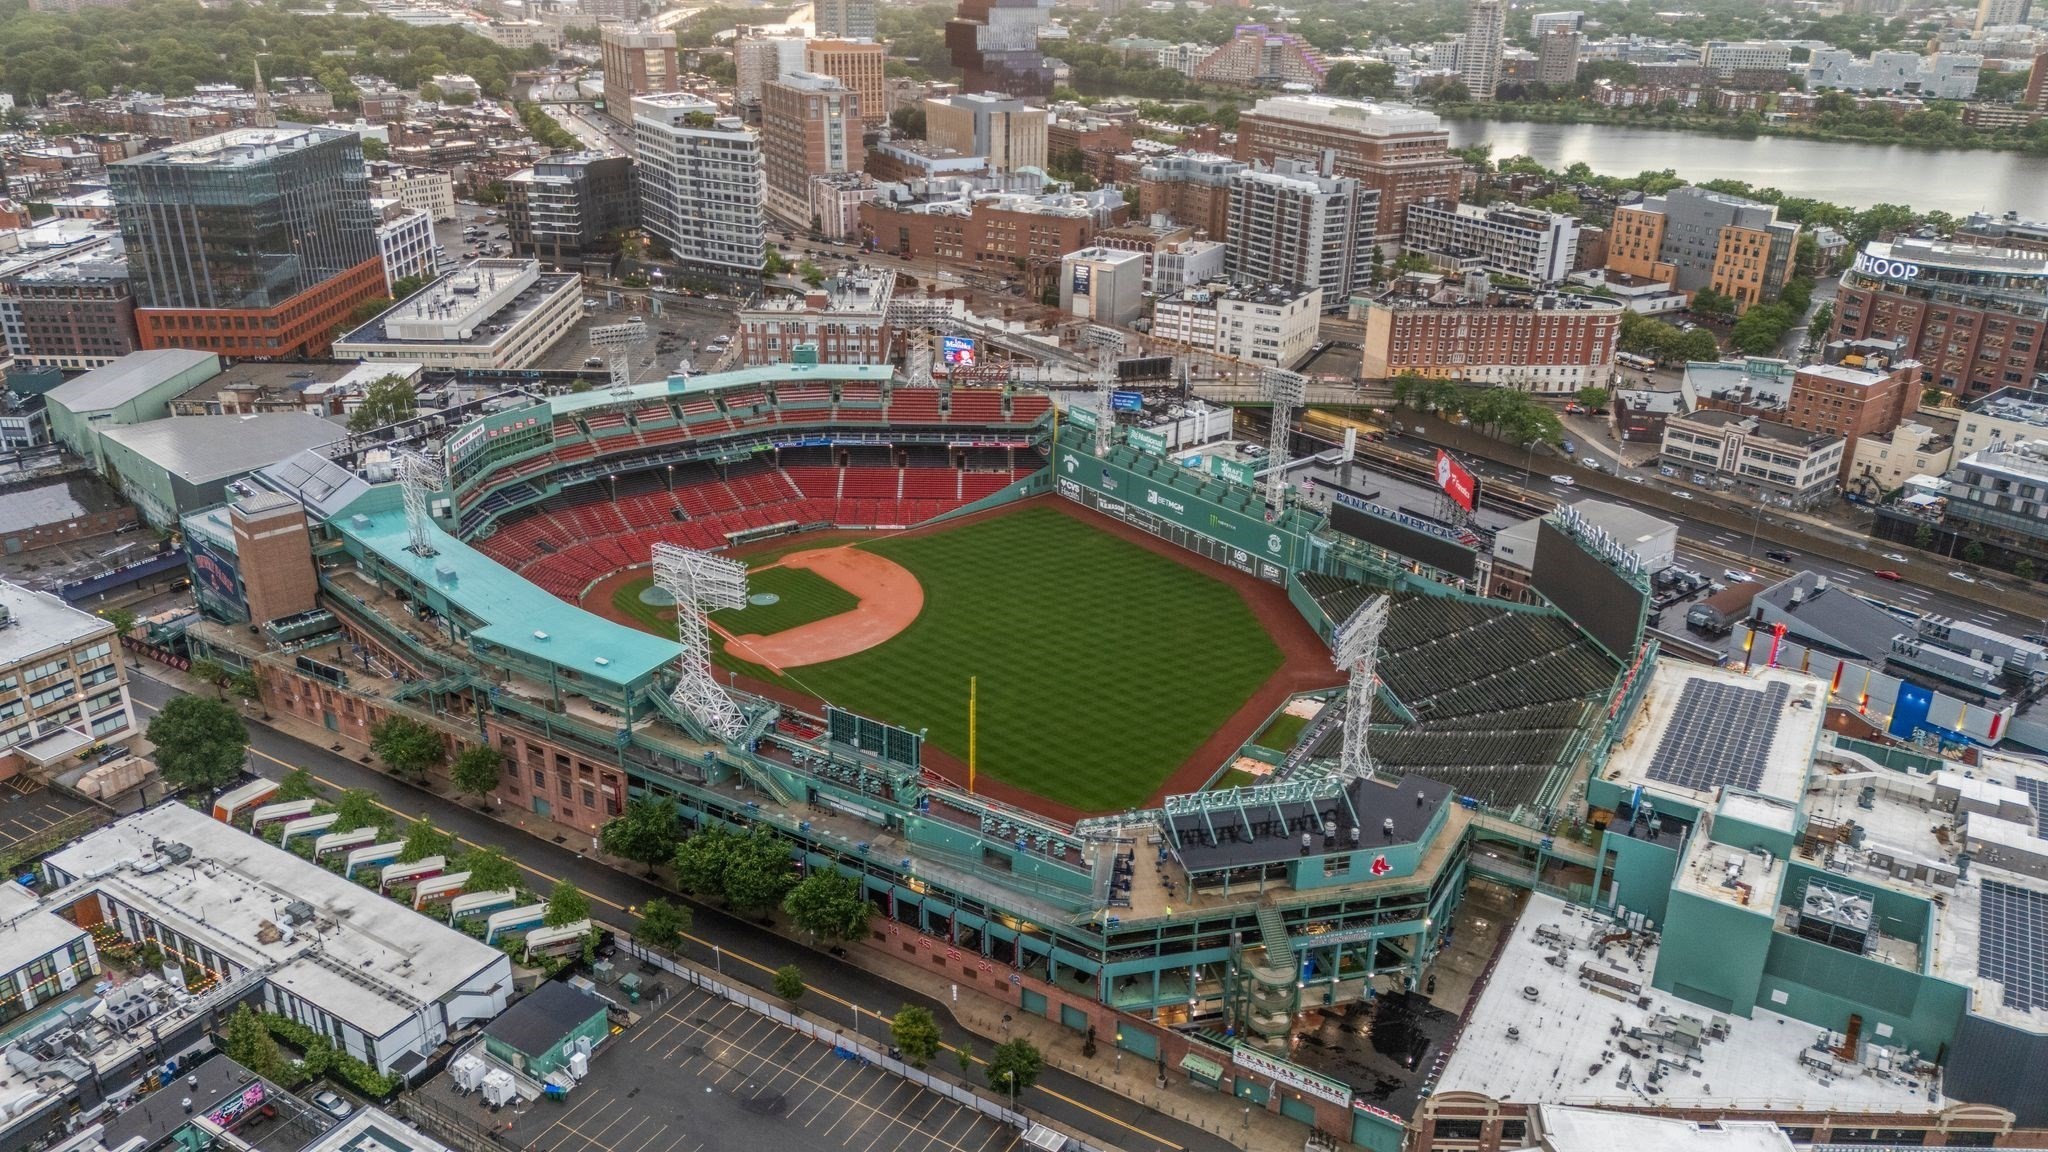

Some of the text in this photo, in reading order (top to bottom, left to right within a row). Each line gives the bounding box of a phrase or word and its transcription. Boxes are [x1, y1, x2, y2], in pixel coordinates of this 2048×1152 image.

[1852, 251, 1918, 280] WHOOP
[454, 436, 471, 449] FENWAY
[472, 427, 483, 438] PARK
[1139, 432, 1163, 447] National
[1221, 465, 1244, 476] DRAFT
[1061, 486, 1080, 501] Health
[1066, 481, 1080, 493] CVS
[1157, 496, 1184, 513] BETMGM
[1337, 491, 1449, 538] BANK OF AMERICA
[1565, 505, 1640, 574] MassMutual
[126, 561, 141, 569] TEAM
[142, 556, 158, 565] STORE
[888, 924, 900, 936] 14
[918, 937, 932, 950] 45
[946, 947, 961, 961] 26
[978, 961, 994, 973] 34
[1009, 973, 1021, 985] 42
[1236, 1051, 1298, 1078] FENWAY
[1303, 1077, 1346, 1100] PARK
[1353, 1099, 1391, 1119] GATE
